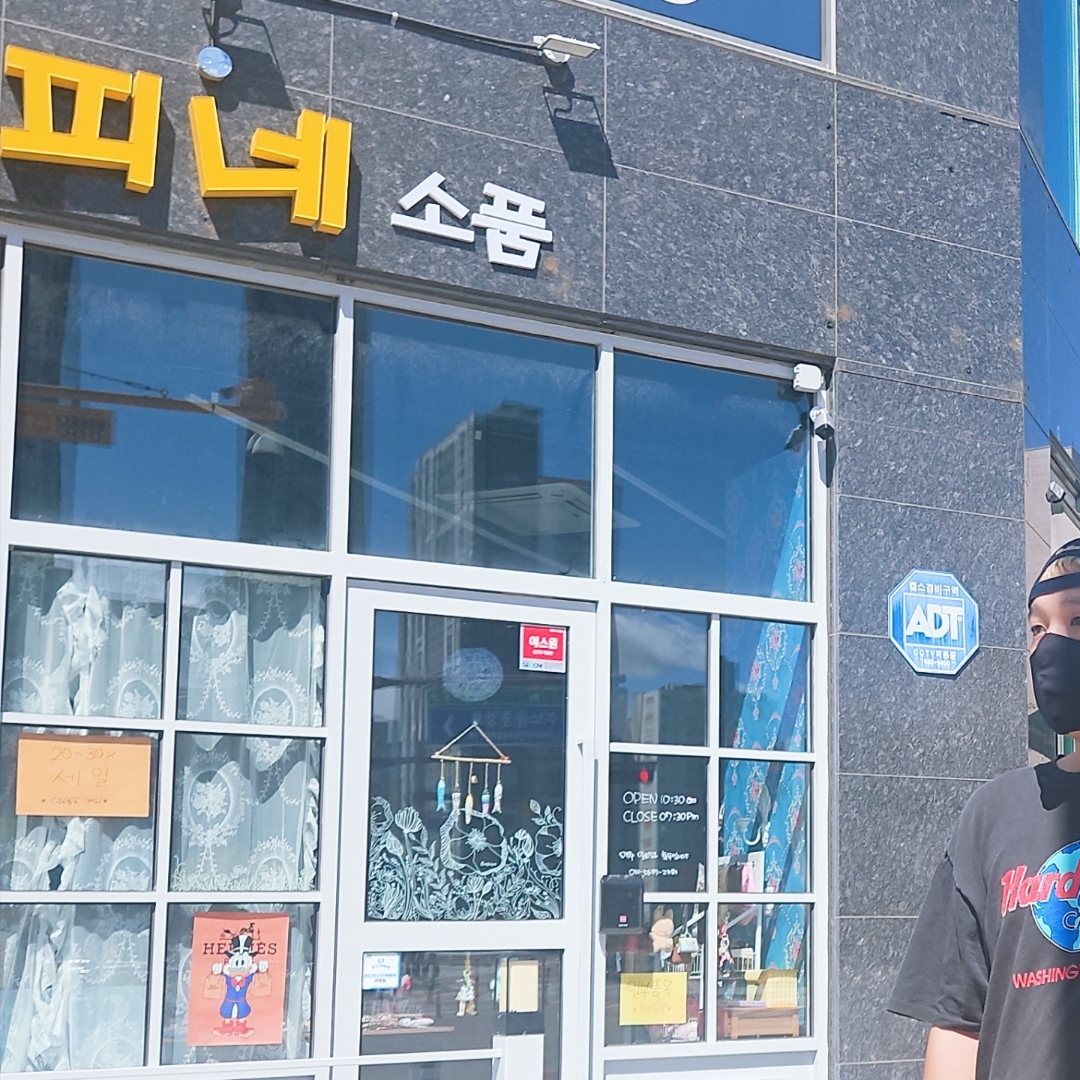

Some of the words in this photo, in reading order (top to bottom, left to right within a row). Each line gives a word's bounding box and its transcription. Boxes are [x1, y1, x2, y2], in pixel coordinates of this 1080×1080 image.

[391, 171, 553, 270] 소품
[905, 603, 964, 641] ADT
[528, 635, 559, 650] 에스원
[51, 746, 117, 761] 20~30%
[52, 767, 109, 788] 세일
[623, 791, 658, 805] OPEN
[623, 811, 658, 823] CLOSE
[203, 942, 277, 955] HEÈS
[627, 980, 673, 1000] 일부품목
